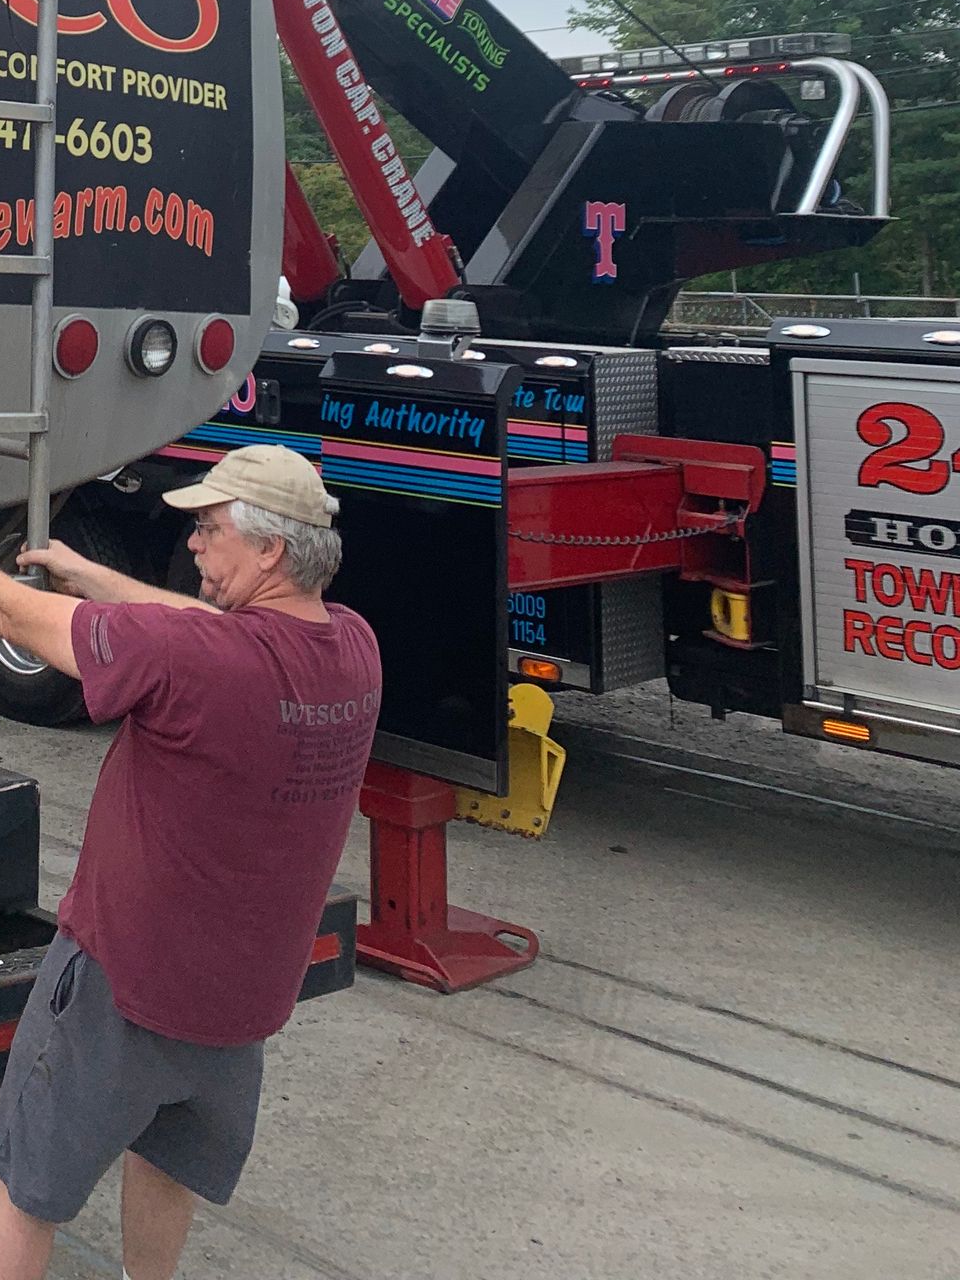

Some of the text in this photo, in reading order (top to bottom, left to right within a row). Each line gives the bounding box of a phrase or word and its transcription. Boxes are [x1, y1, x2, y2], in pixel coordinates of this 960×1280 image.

[462, 10, 509, 67] TOWING
[123, 68, 227, 110] PROVIDER
[371, 132, 436, 247] CRANE
[585, 201, 626, 281] T
[365, 401, 485, 448] Authority
[871, 517, 960, 551] HO
[512, 620, 546, 645] 1154
[843, 609, 960, 670] RECO
[280, 700, 357, 726] WESCO
